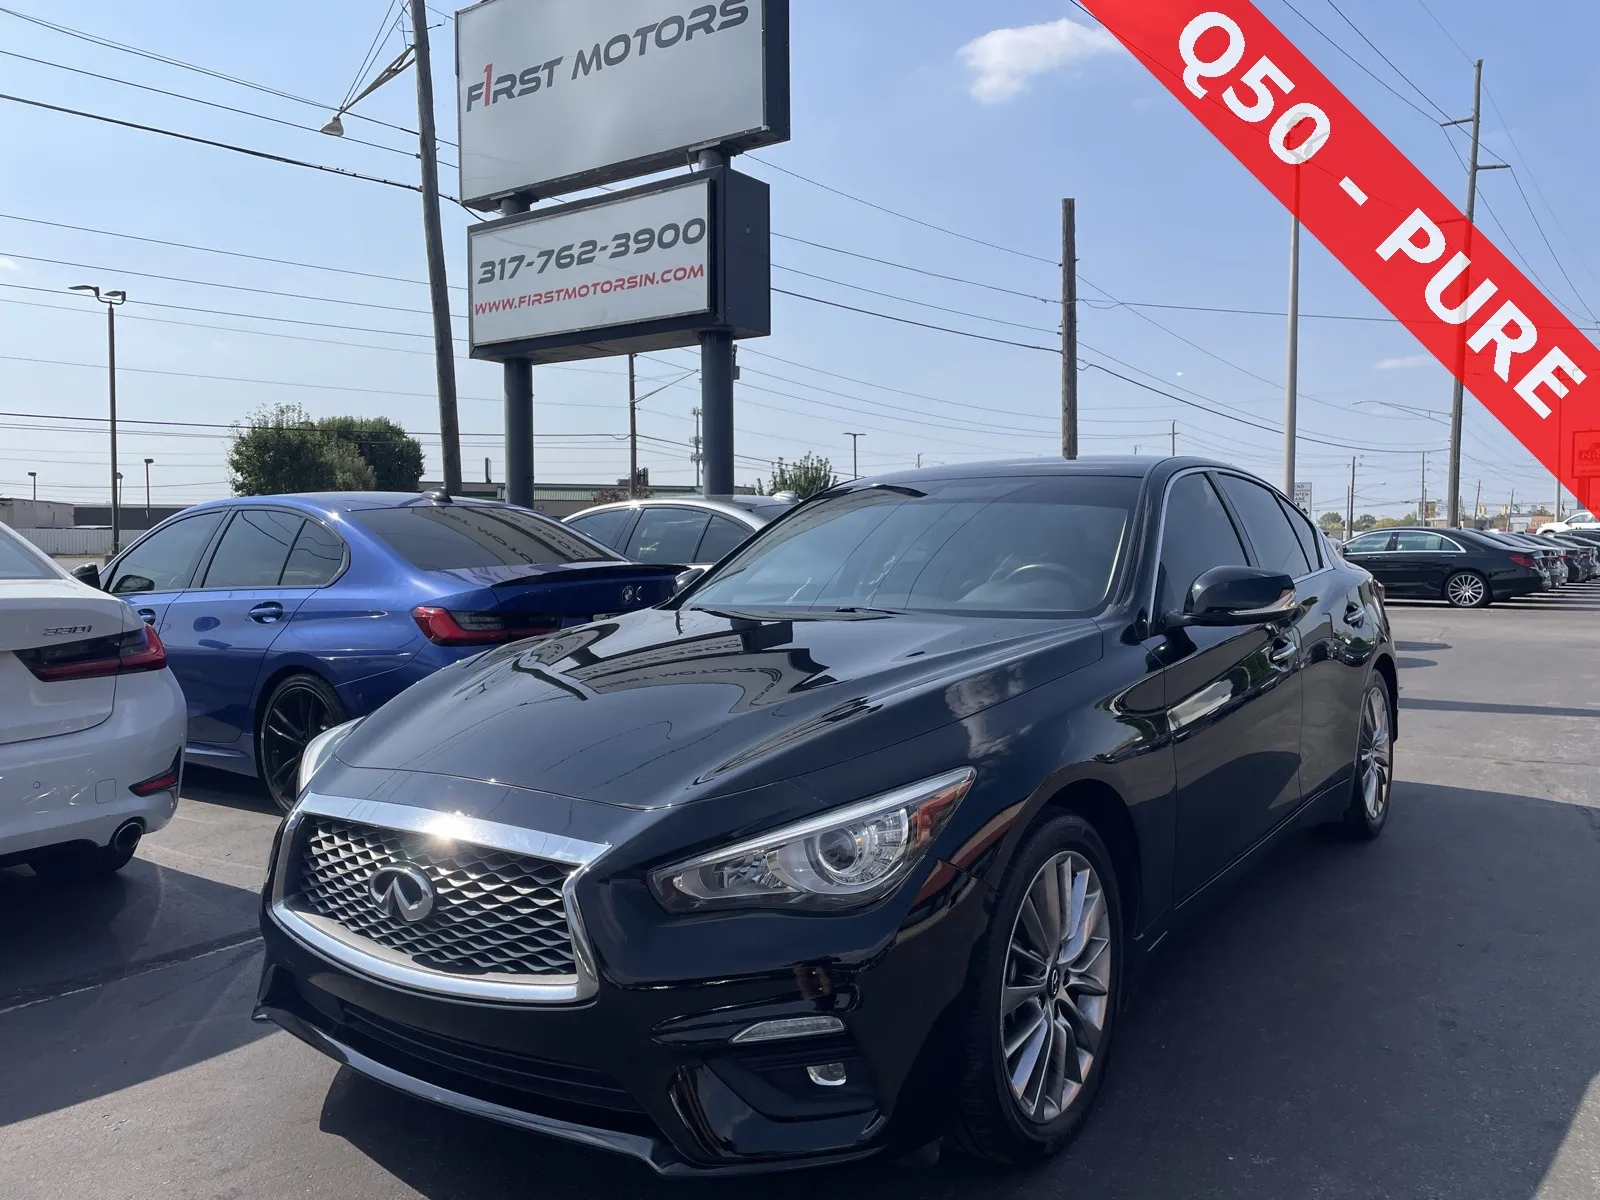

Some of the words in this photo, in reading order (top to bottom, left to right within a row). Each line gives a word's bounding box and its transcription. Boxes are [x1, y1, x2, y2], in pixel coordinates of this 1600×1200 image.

[571, 0, 749, 80] MOTORS
[477, 218, 706, 285] 317-762-3900
[474, 263, 705, 315] WWW.FIRSTMOTORSIN.COM
